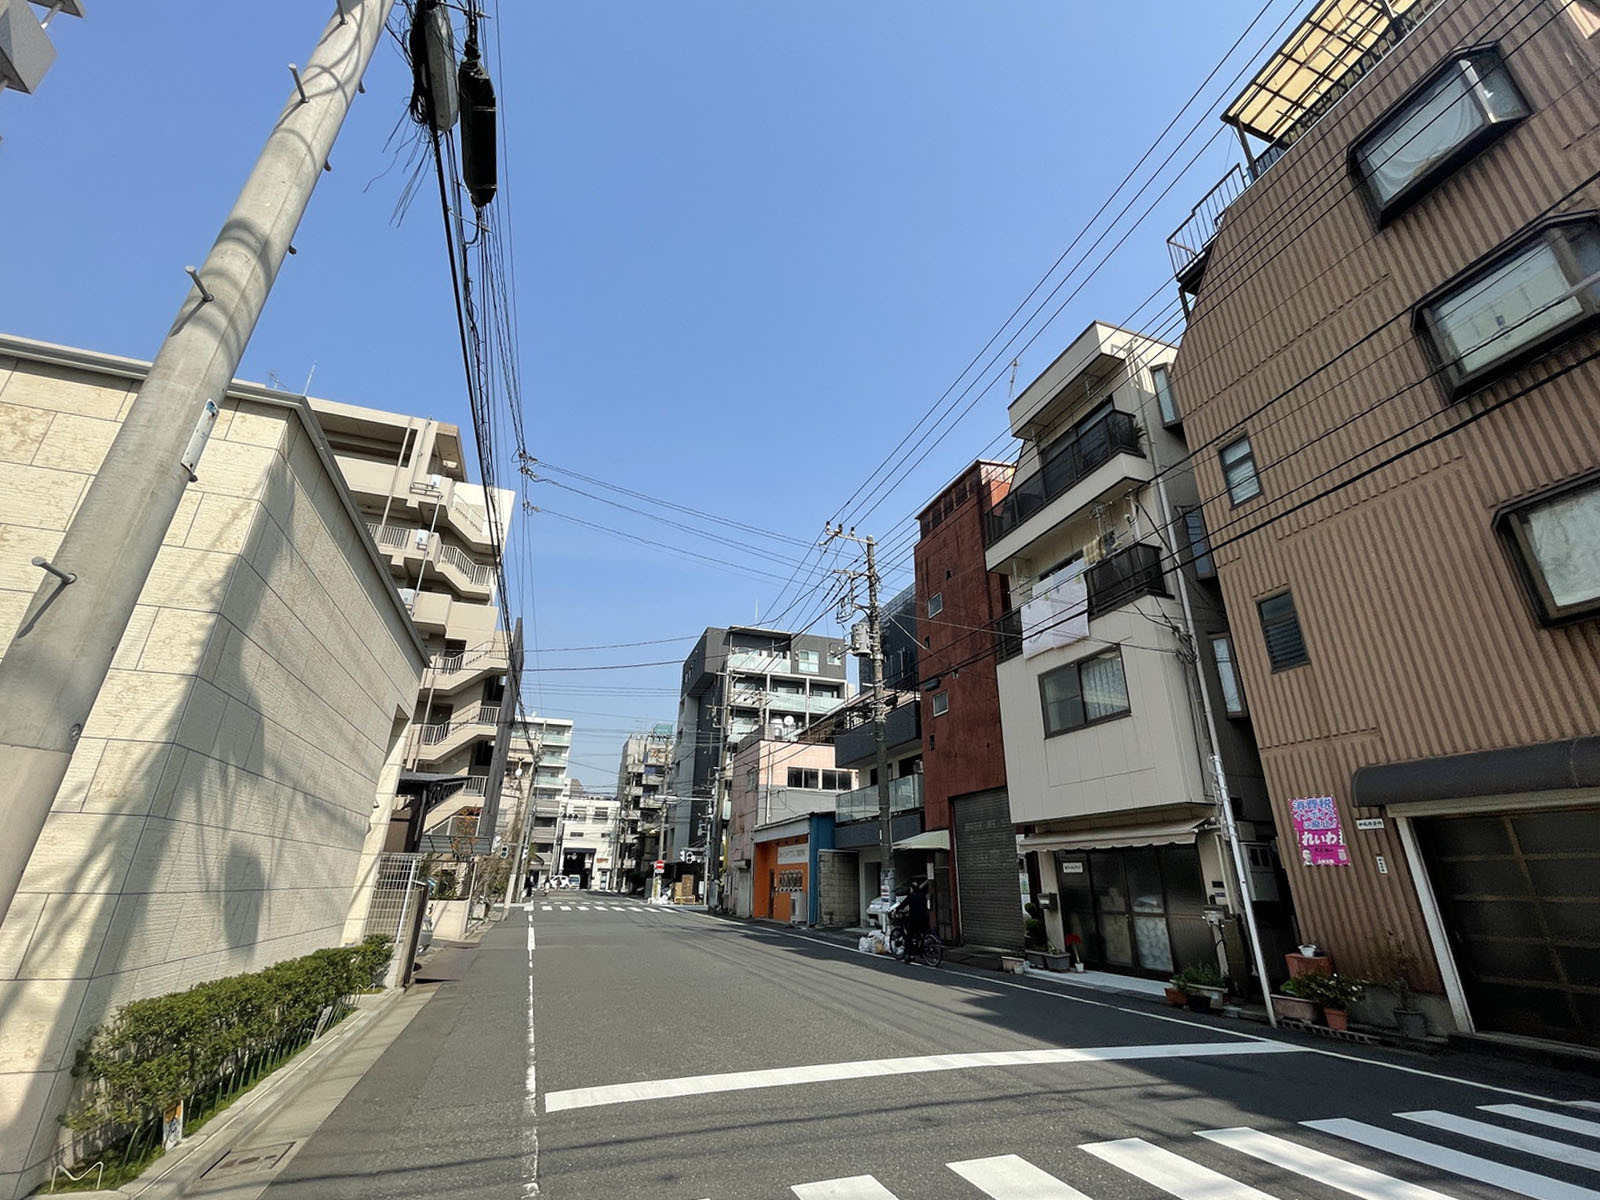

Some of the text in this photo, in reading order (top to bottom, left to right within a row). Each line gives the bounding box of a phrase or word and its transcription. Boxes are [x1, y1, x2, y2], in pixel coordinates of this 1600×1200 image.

[1293, 798, 1331, 810] 消費税
[1294, 808, 1335, 820] インボイス
[1302, 831, 1338, 846] れいわ
